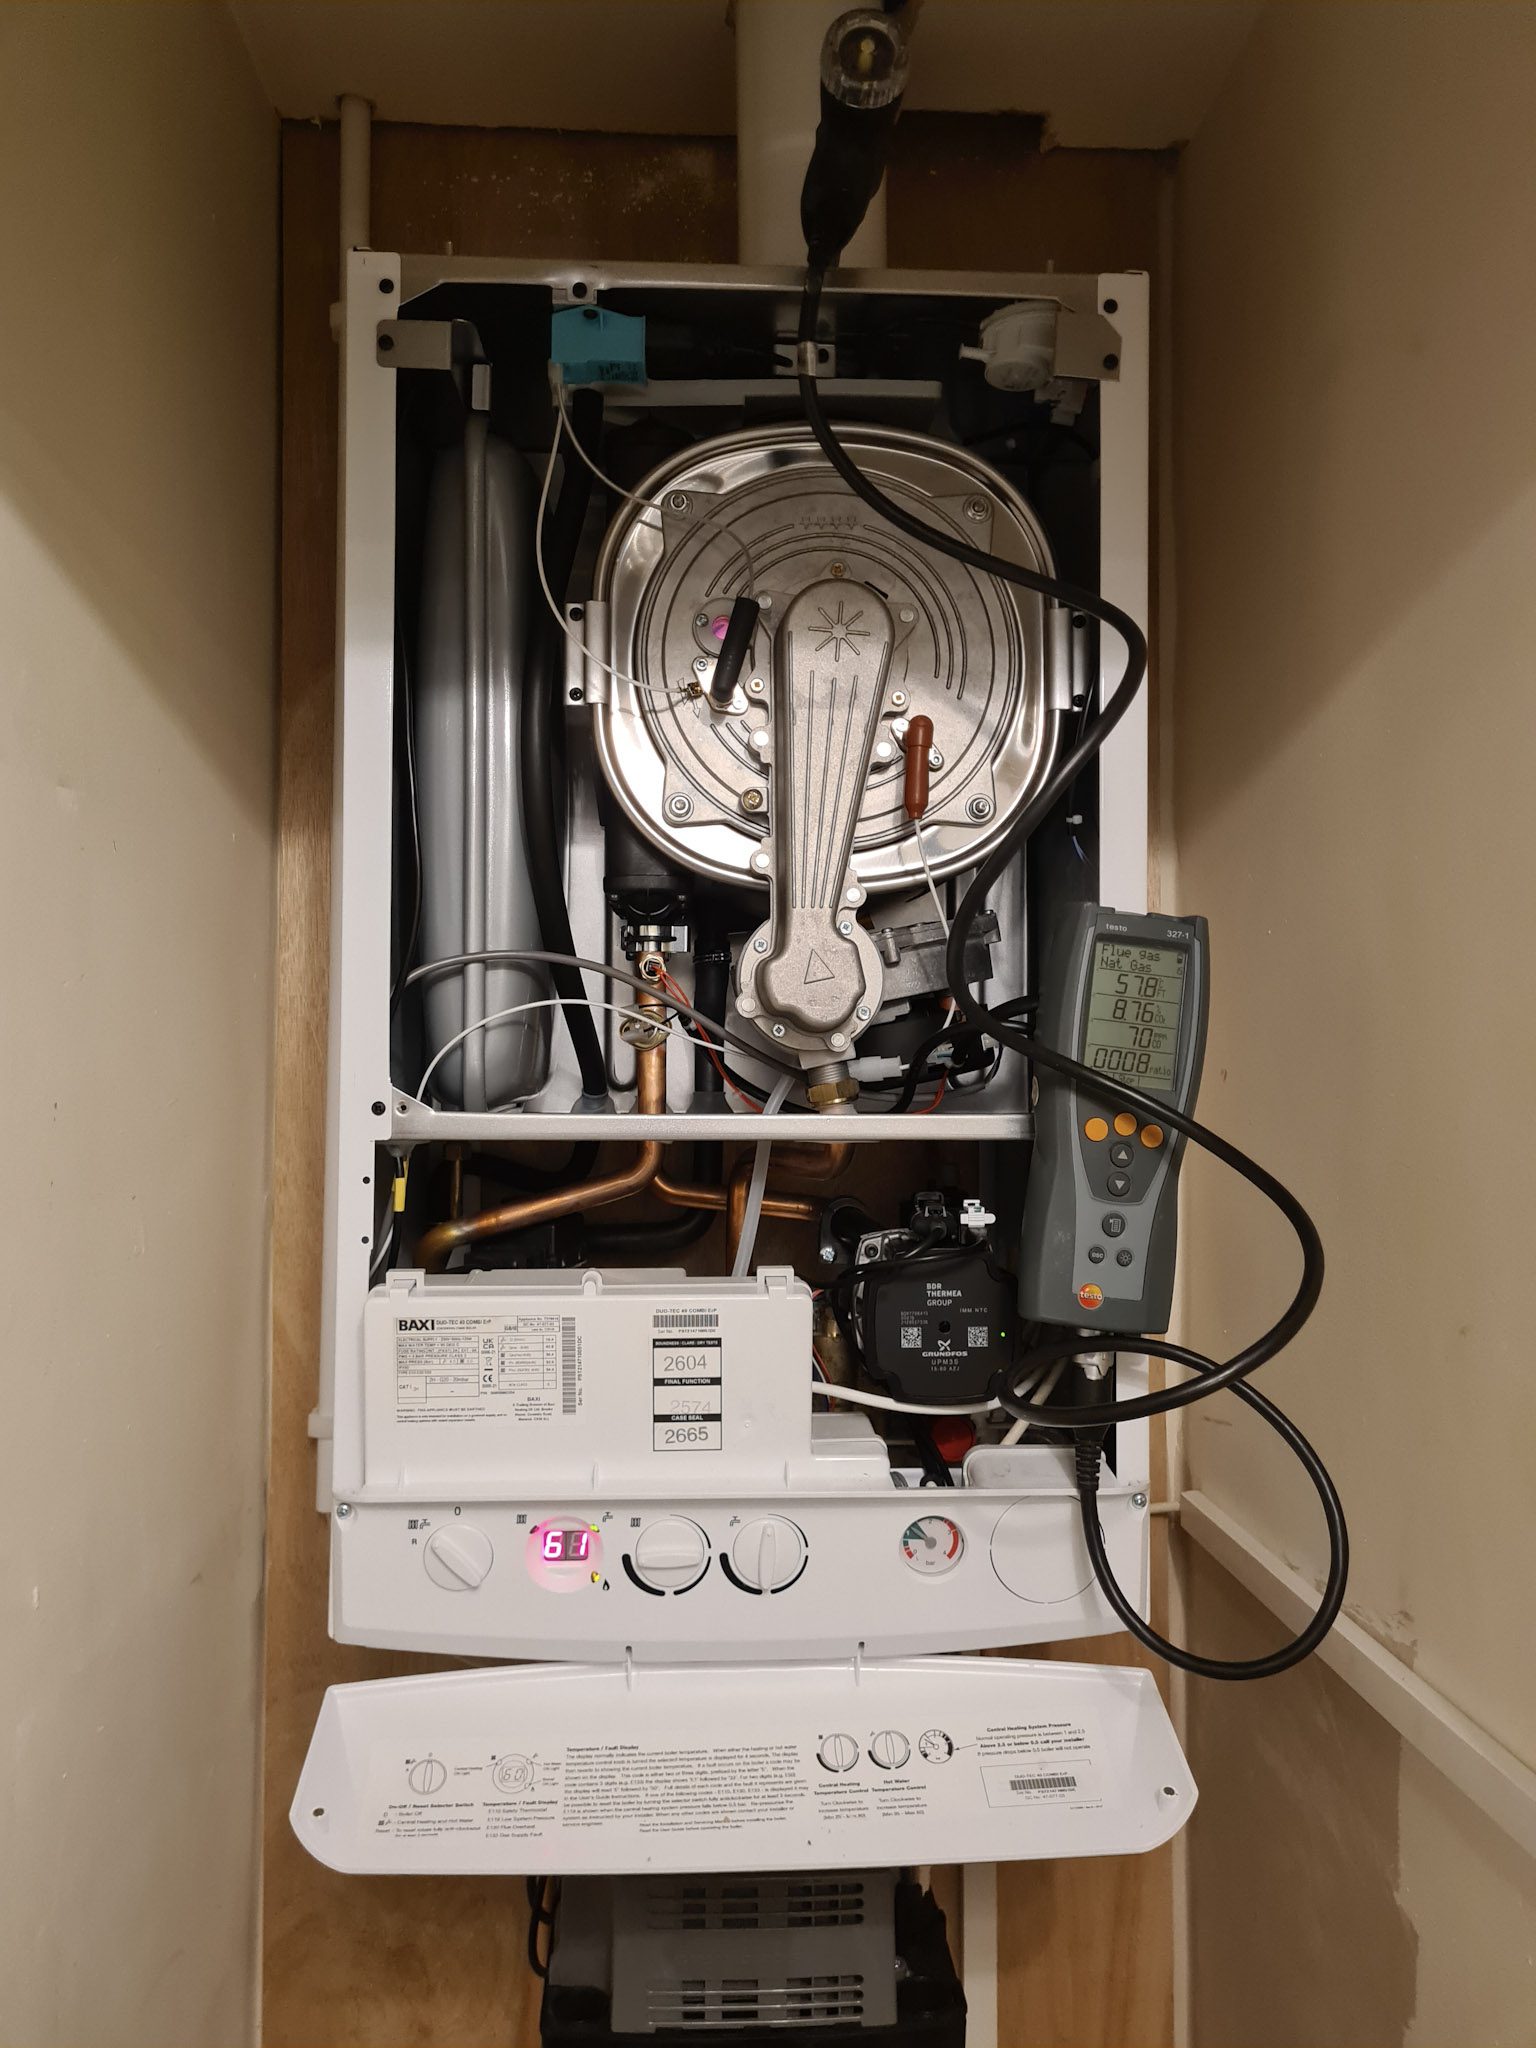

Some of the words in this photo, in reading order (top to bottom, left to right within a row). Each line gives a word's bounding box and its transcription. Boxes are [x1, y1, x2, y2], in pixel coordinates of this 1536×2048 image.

[1105, 923, 1128, 932] testo
[1166, 930, 1189, 939] 327-1
[1101, 944, 1132, 958] Flue
[1139, 950, 1160, 962] gas
[1100, 956, 1123, 970] Nat
[1130, 959, 1152, 973] Gas
[1114, 973, 1159, 998] 57.8
[1112, 998, 1154, 1023] 8.76
[1128, 1025, 1153, 1048] 70
[1151, 1039, 1162, 1049] CO
[1093, 1047, 1151, 1074] 0008
[1149, 1066, 1171, 1077] ratio
[1091, 1251, 1104, 1259] esc
[926, 1282, 942, 1290] BDR
[926, 1289, 962, 1297] THERMEA
[926, 1298, 953, 1307] GROUP
[1080, 1290, 1103, 1301] testo
[398, 1319, 435, 1332] BAXI
[663, 1354, 708, 1372] 2604
[482, 1374, 493, 1383] CE
[670, 1399, 712, 1414] 2574
[664, 1426, 709, 1444] 2665
[544, 1531, 588, 1558] 61
